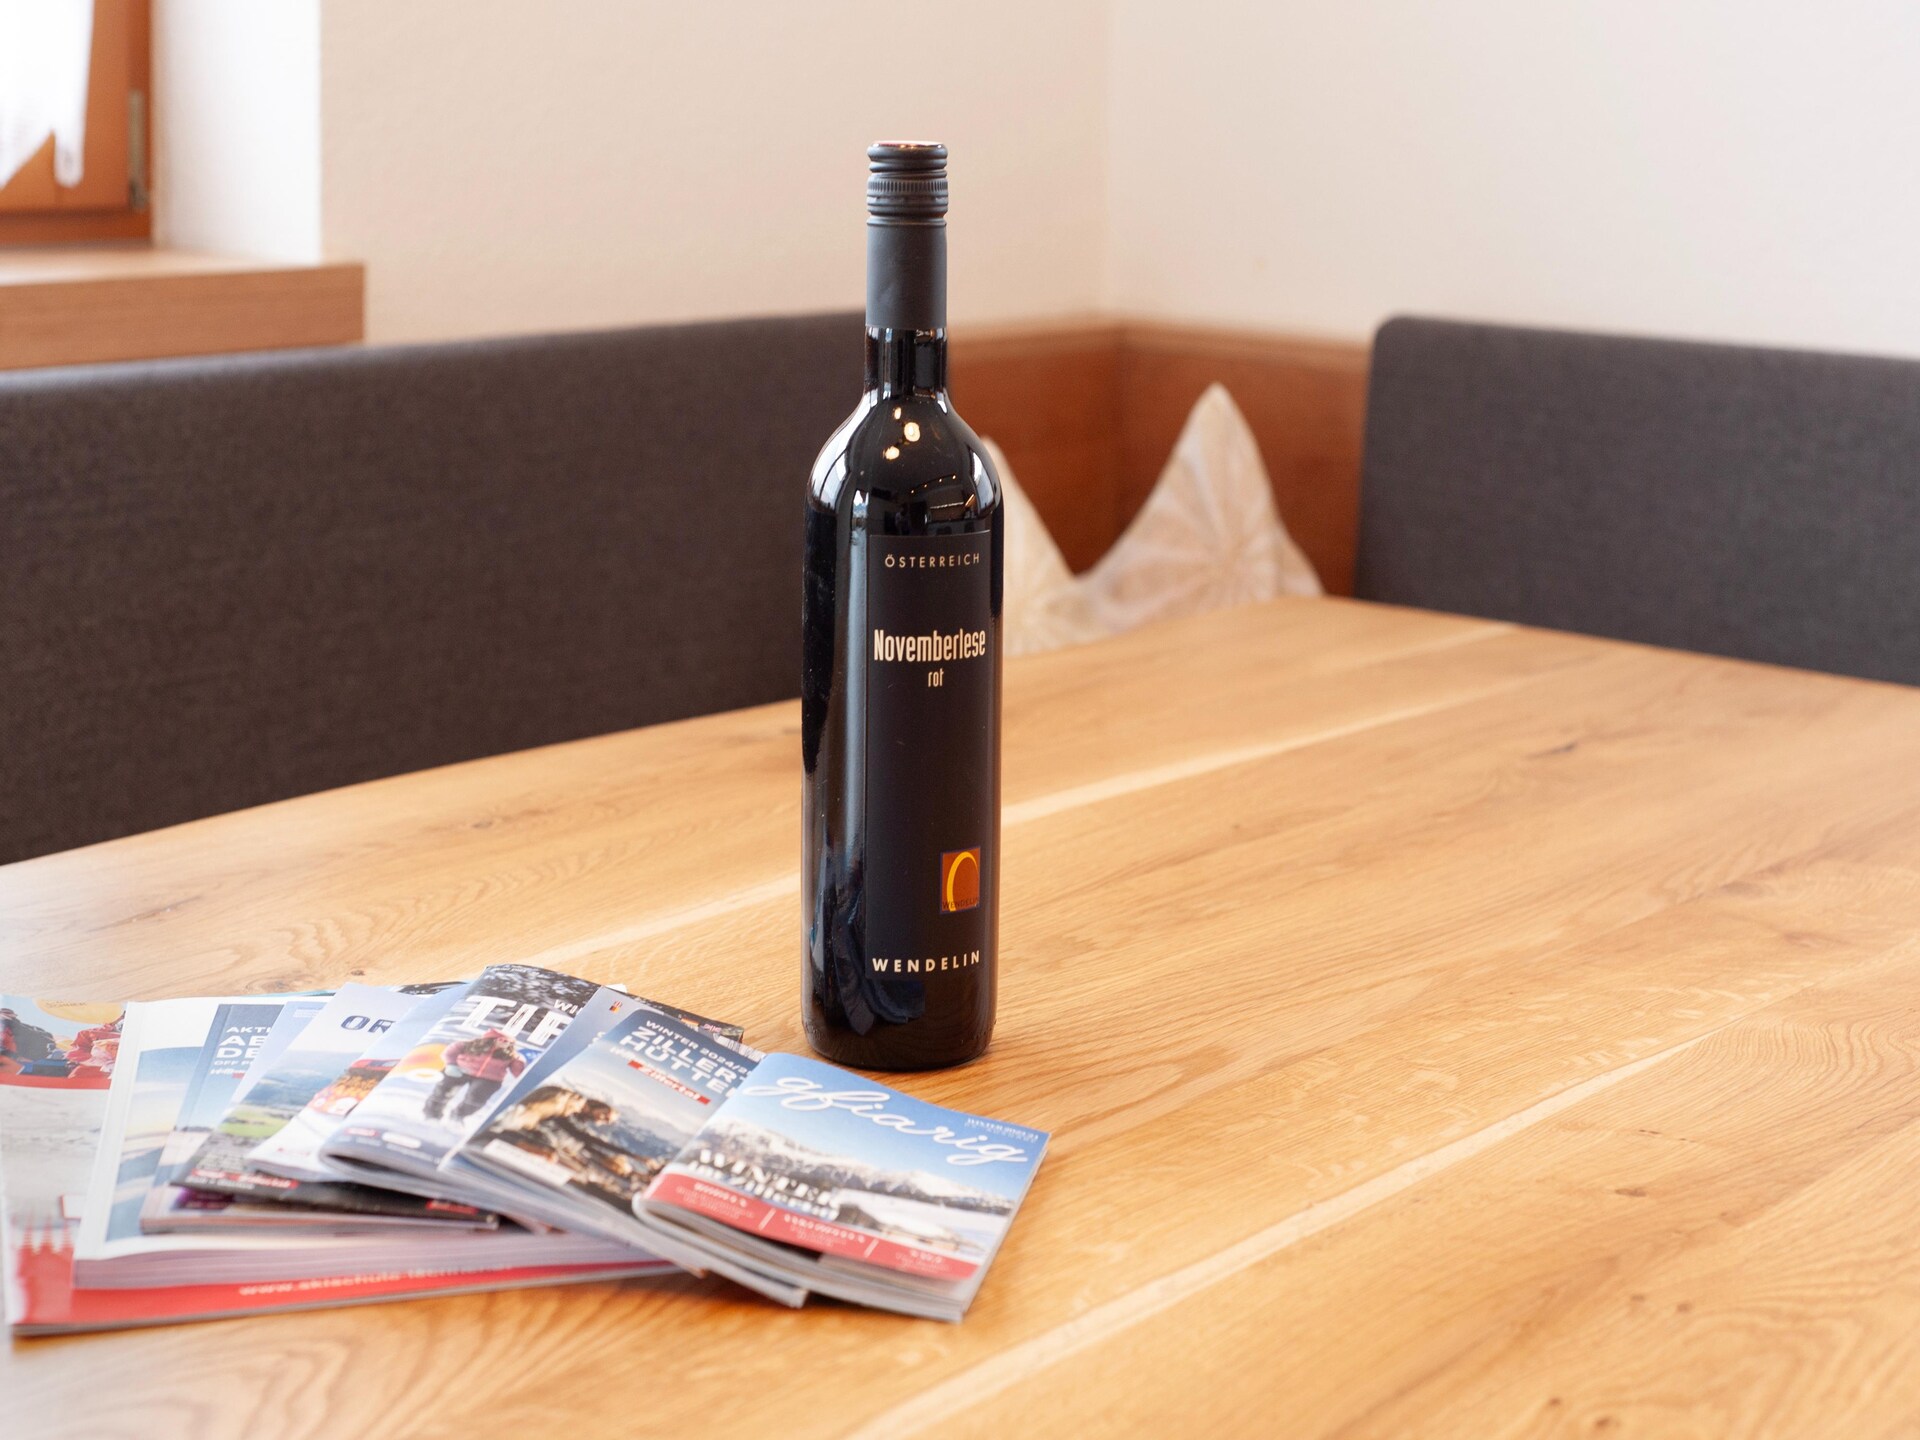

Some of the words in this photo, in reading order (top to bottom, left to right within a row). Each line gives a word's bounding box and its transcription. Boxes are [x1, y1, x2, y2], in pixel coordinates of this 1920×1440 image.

[884, 553, 980, 568] ÖSTERREICH
[874, 628, 986, 662] Novemberlese
[927, 668, 944, 687] rot
[872, 950, 980, 973] WENDELIN
[646, 1020, 699, 1050] WINTER
